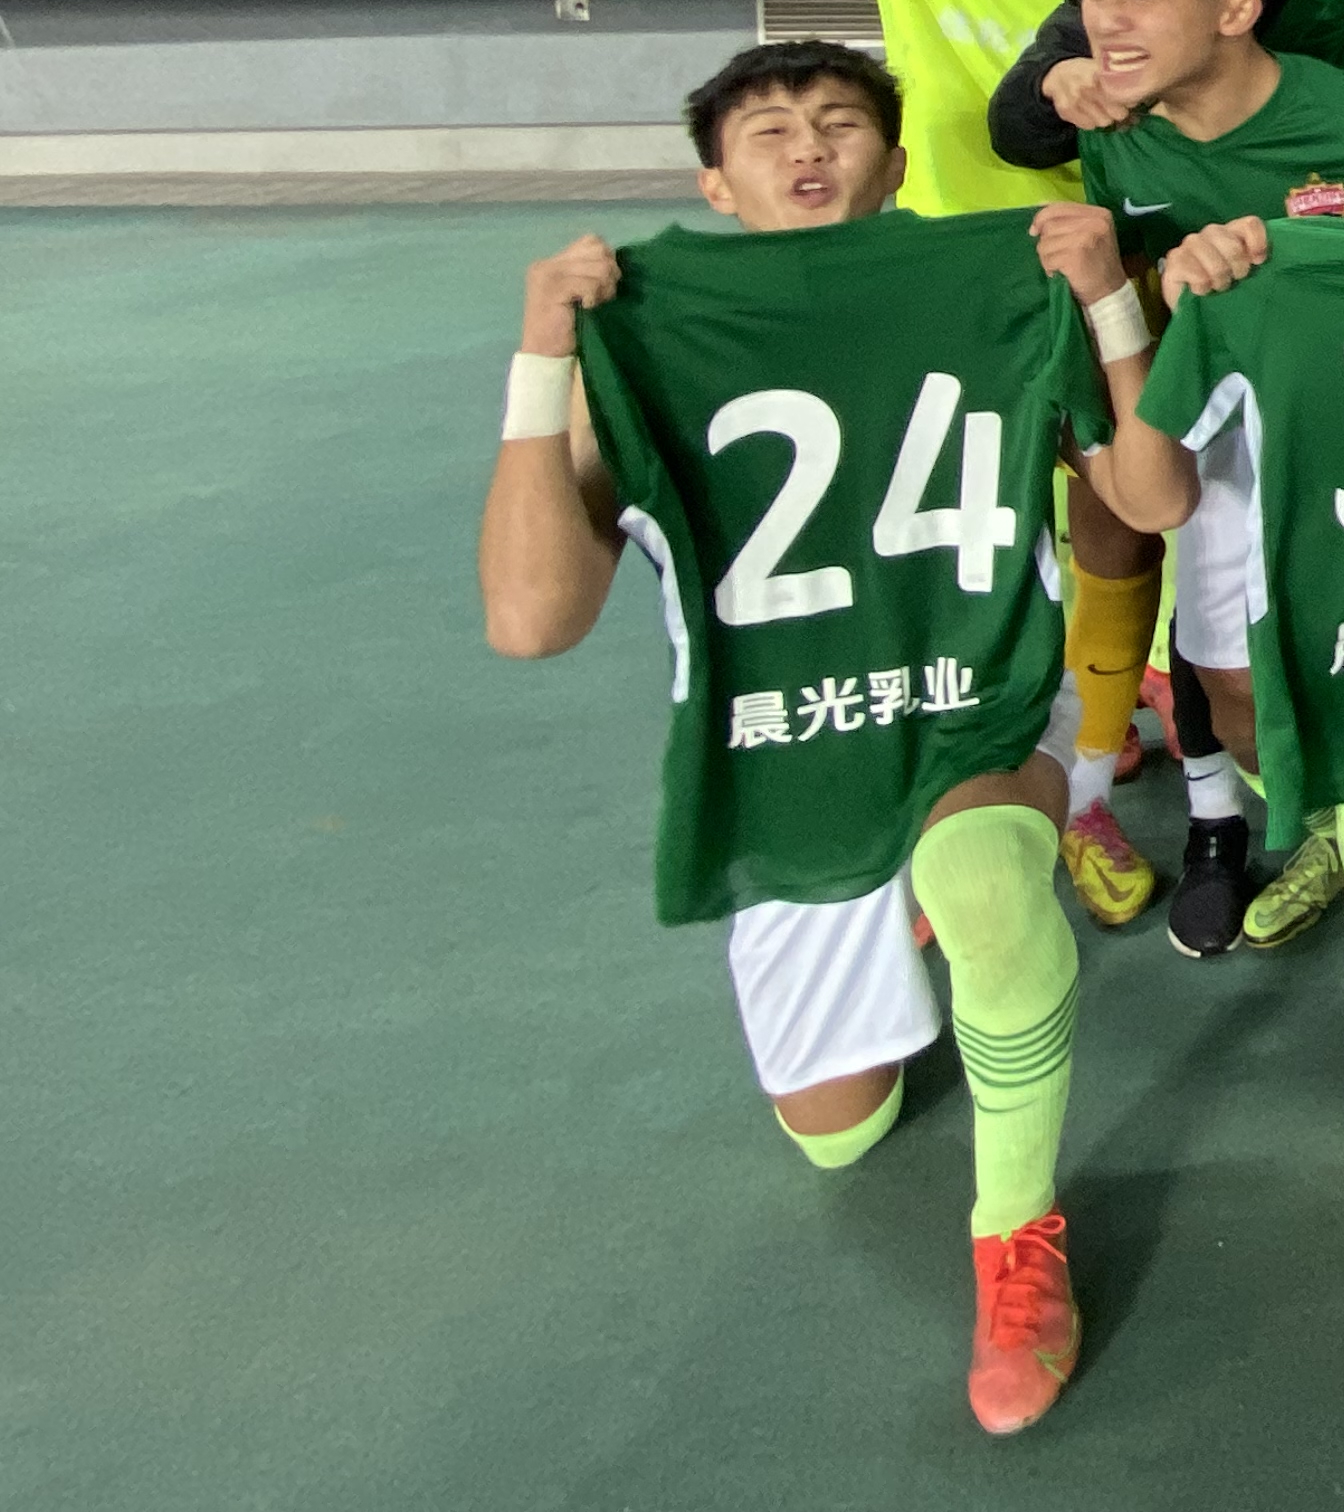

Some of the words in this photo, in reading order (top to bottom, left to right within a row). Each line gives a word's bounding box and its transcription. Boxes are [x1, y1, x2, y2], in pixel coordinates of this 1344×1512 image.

[706, 372, 1016, 625] 24
[729, 656, 980, 749] 晨光乳业
